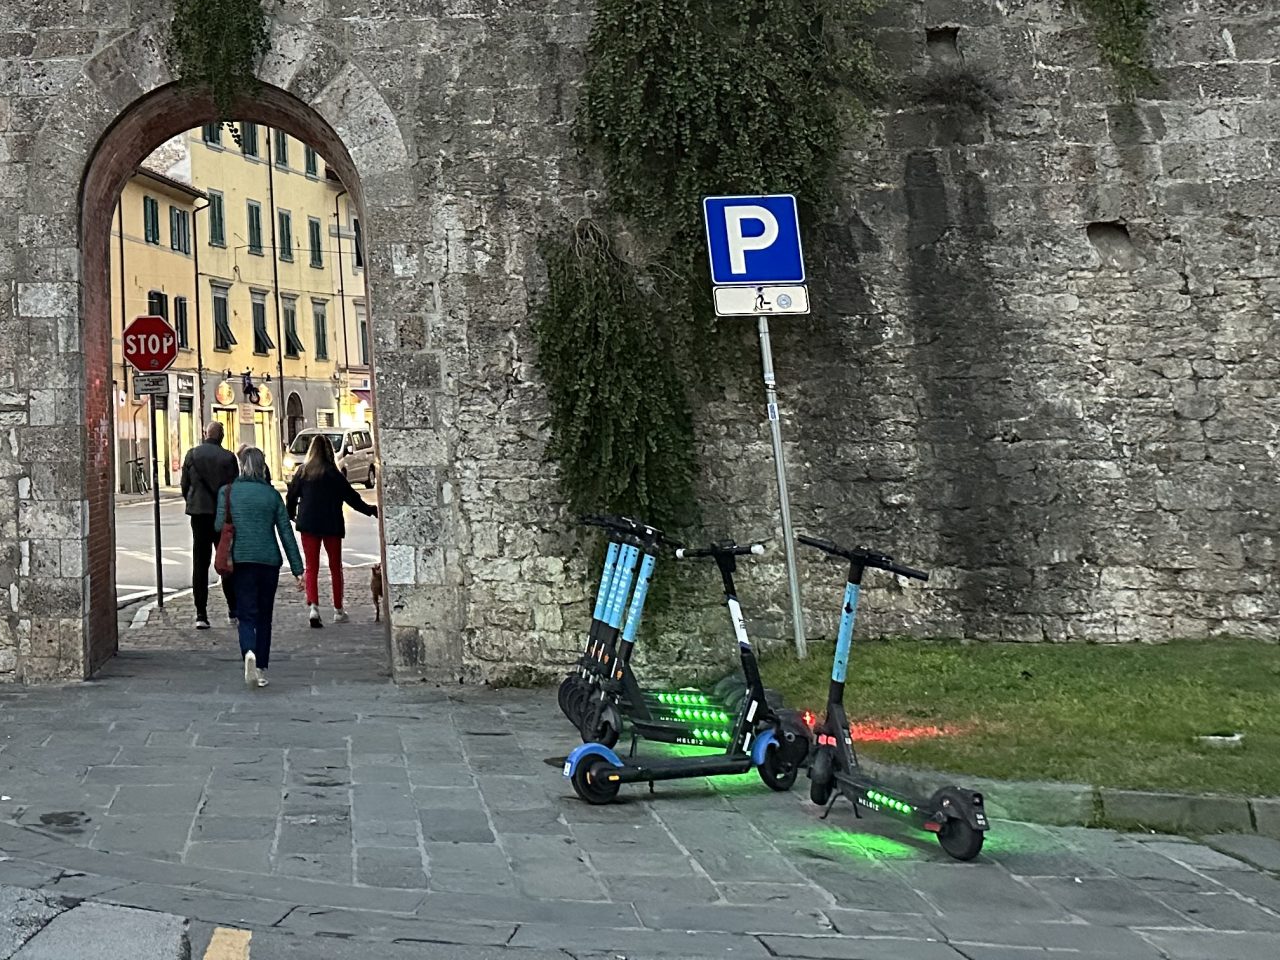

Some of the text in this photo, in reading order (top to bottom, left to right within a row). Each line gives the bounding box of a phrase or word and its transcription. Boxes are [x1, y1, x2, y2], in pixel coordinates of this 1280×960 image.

[724, 205, 779, 274] P
[126, 333, 174, 355] STOP
[597, 562, 612, 606] HELBIZ
[606, 565, 622, 608] HELBIZ
[613, 567, 630, 613] HELBIZ
[627, 576, 645, 624] HELBIZ
[676, 737, 704, 746] HELBIZ
[858, 797, 880, 811] HELBIZ
